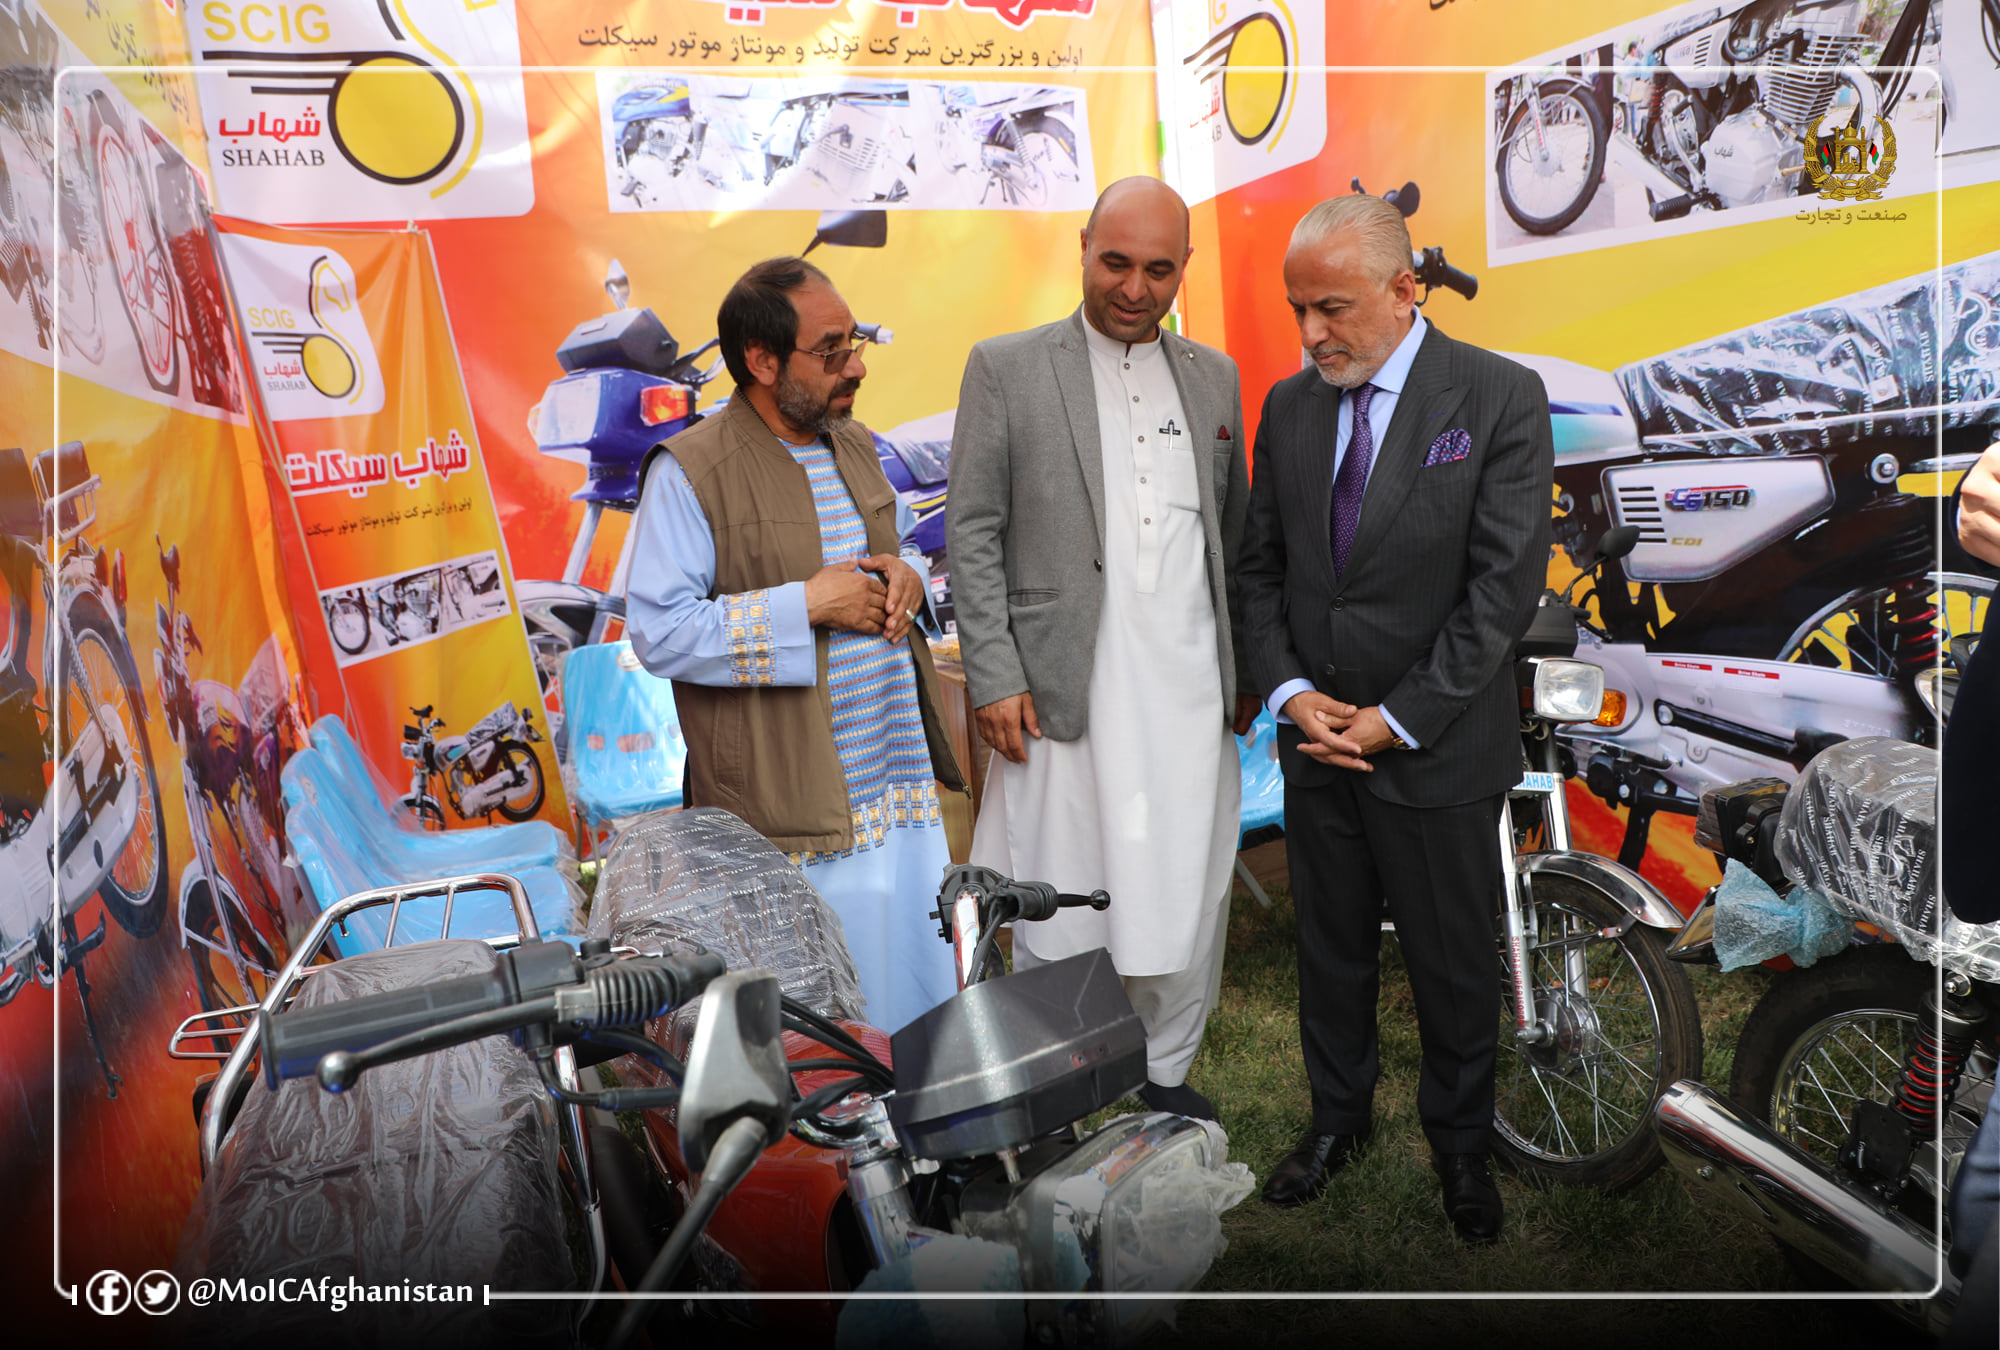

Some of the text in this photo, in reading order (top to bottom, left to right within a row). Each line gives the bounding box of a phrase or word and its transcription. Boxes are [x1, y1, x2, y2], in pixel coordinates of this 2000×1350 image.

[203, 1, 331, 44] SCIG
[578, 25, 658, 52] سیکلت
[668, 31, 722, 58] موتور
[731, 35, 787, 62] مونتاژ
[812, 36, 860, 61] تولید
[868, 36, 931, 64] شرکت
[794, 44, 805, 63] و
[1031, 49, 1040, 67] و
[1046, 44, 1083, 72] اولین
[219, 106, 321, 144] شهاب
[222, 149, 325, 167] SHAHAB
[247, 307, 296, 329] SCIG
[263, 359, 302, 379] شهاب
[267, 381, 307, 391] SHAHAB
[285, 430, 470, 497] شهاب سیکلت
[1671, 537, 1703, 546] CDI
[1520, 774, 1553, 789] AHAB
[1513, 970, 1524, 994] SUPER
